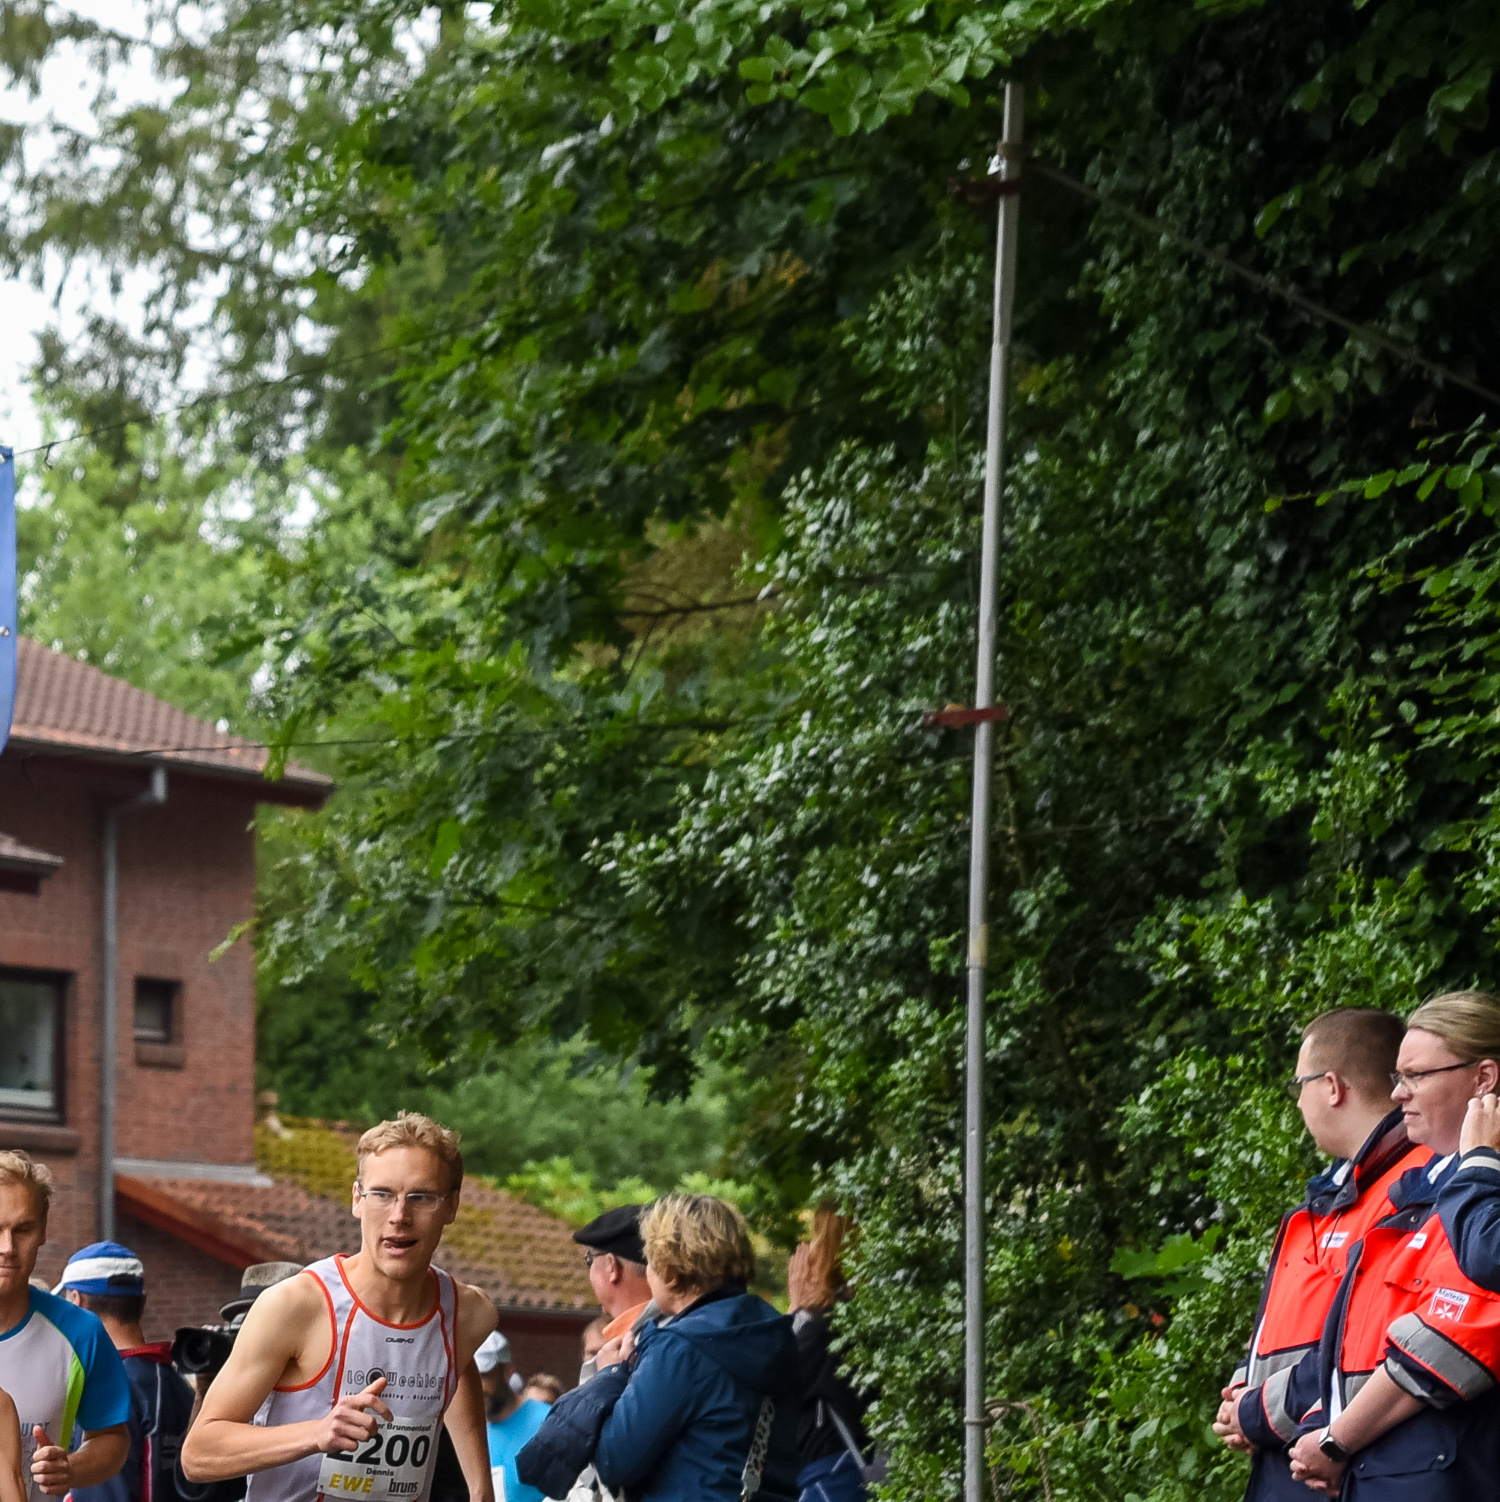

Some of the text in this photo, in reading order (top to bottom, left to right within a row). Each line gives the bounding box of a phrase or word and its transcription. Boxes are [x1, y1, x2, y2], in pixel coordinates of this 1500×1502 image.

[386, 1422, 432, 1432] Brunnenlauf
[326, 1433, 431, 1468] 200
[365, 1467, 395, 1477] Dennis
[329, 1473, 419, 1494] EWE bruns
